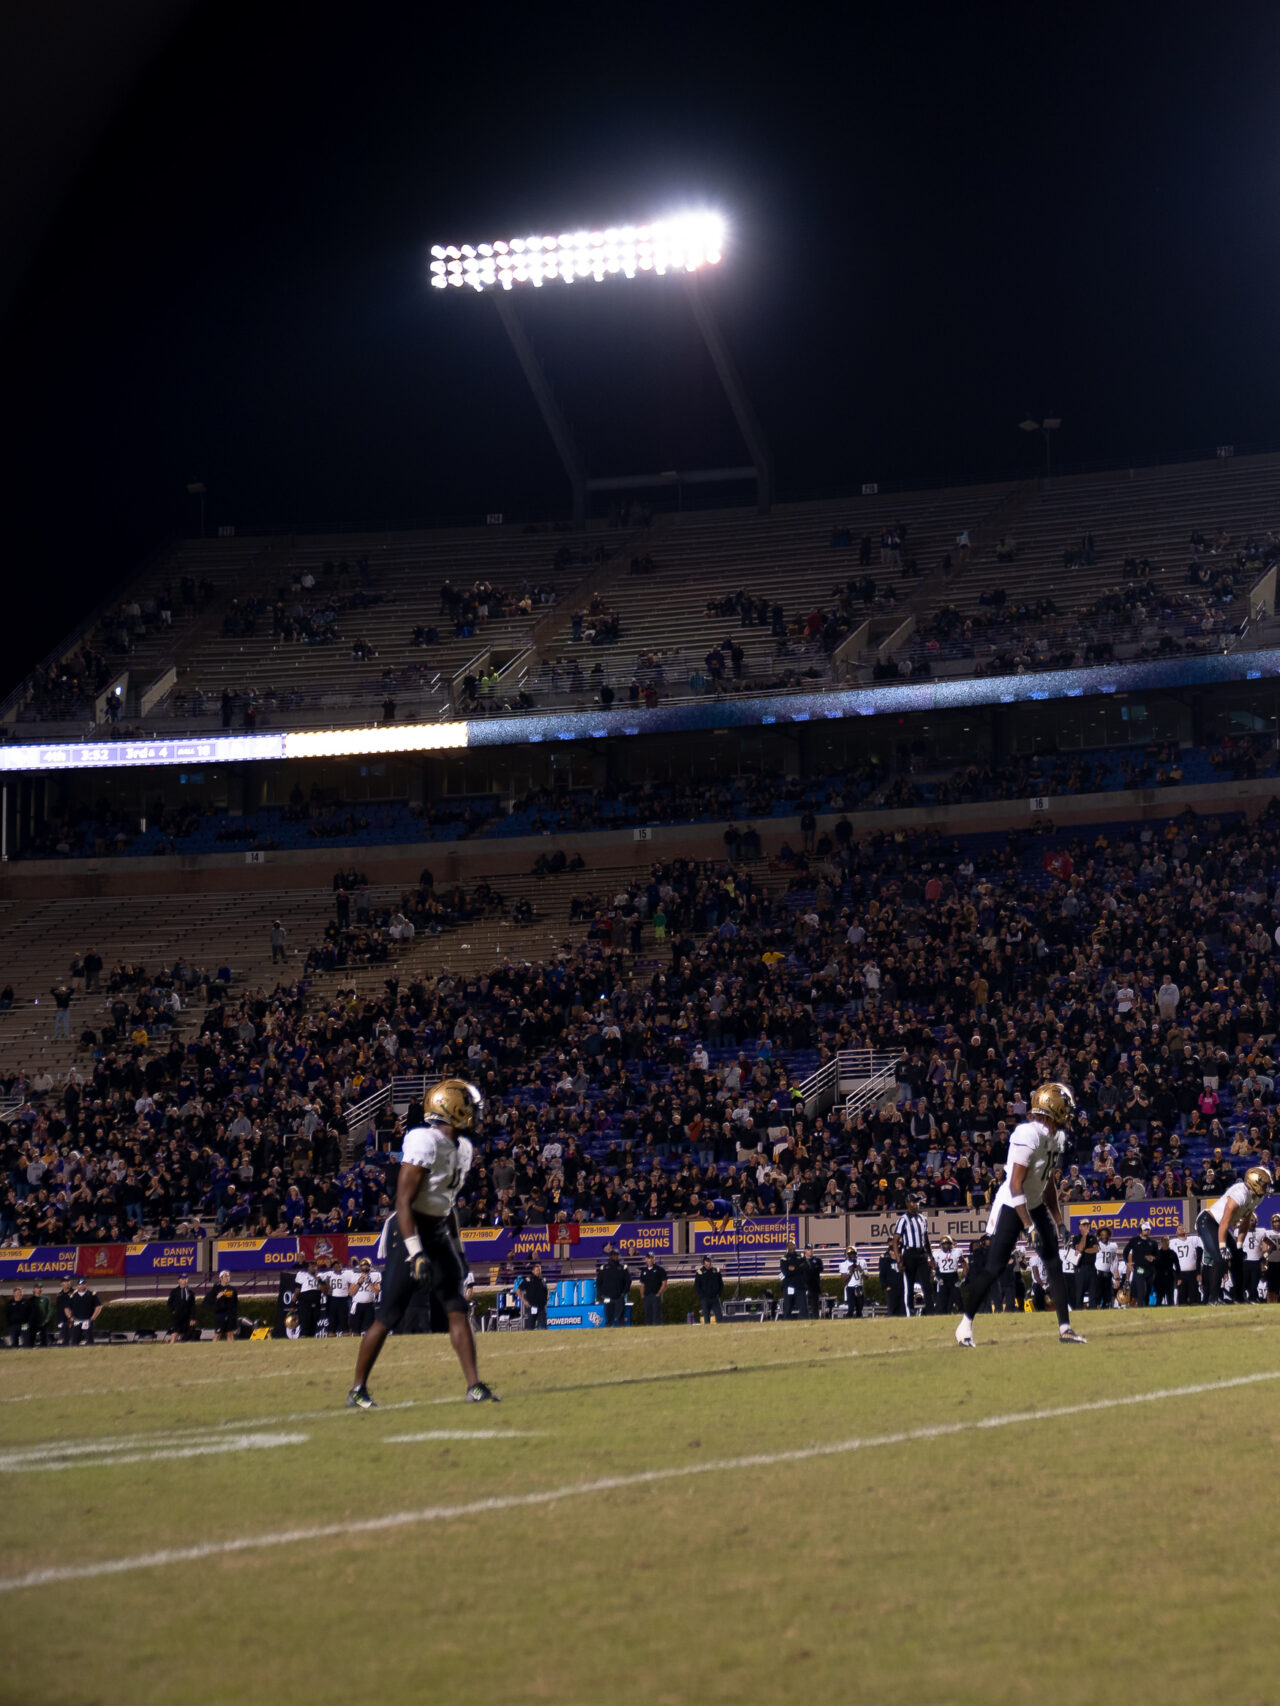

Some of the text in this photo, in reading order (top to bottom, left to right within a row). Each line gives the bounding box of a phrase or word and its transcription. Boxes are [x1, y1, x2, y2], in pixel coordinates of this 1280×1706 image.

[1035, 799, 1044, 809] 16
[638, 828, 647, 839] 15
[251, 853, 259, 862] 14
[1150, 1206, 1179, 1215] BOWL
[743, 1223, 796, 1232] CONFERENCE
[948, 1220, 988, 1234] FIELD
[1091, 1217, 1180, 1230] APPEARANCES
[462, 1231, 494, 1239] 1977-1980
[637, 1228, 670, 1237] TOOTIE
[620, 1238, 670, 1249] ROBBINS
[703, 1232, 796, 1246] CHAMPIONSHIPS
[163, 1247, 194, 1256] DANNY
[514, 1242, 550, 1254] INMAN
[1177, 1245, 1190, 1258] 57
[153, 1256, 194, 1267] KEPLEY
[941, 1259, 954, 1271] 22
[547, 1316, 581, 1325] POWERADE
